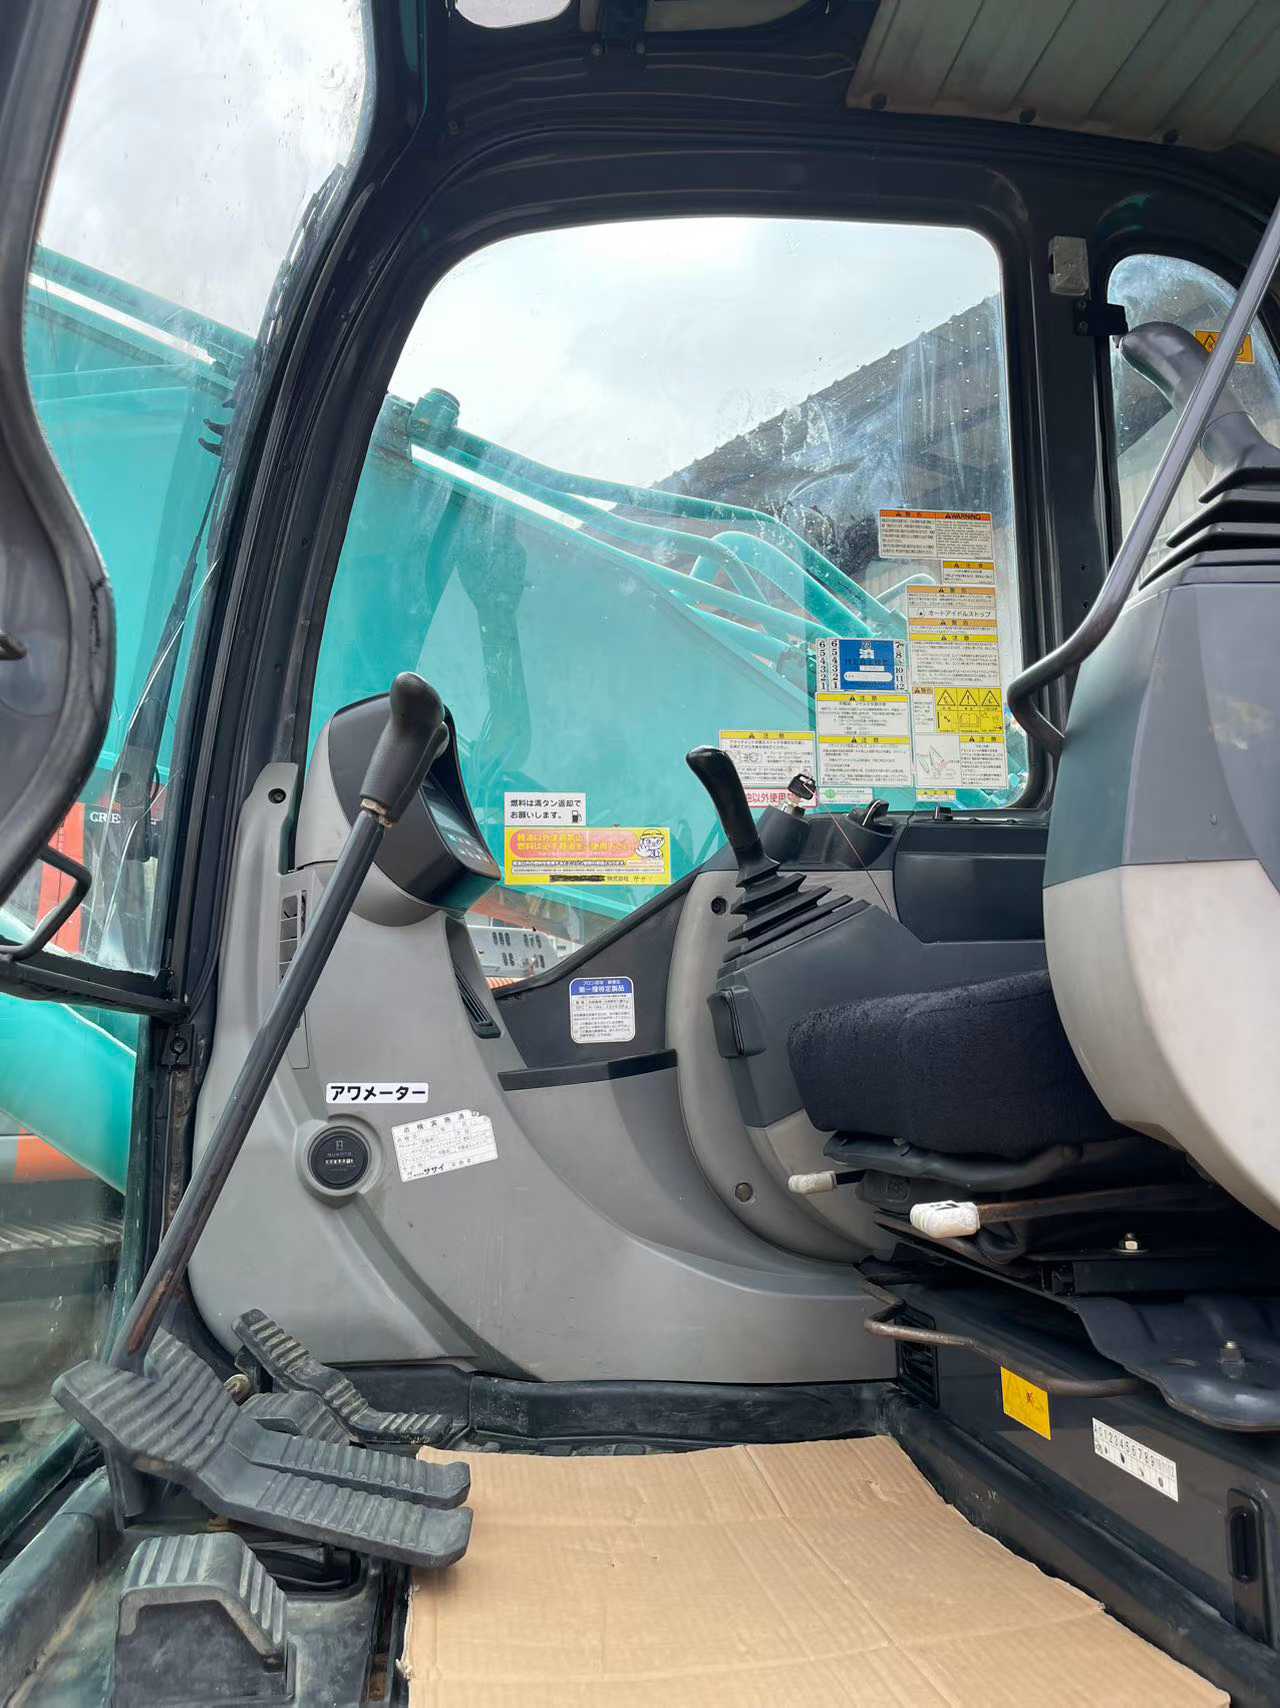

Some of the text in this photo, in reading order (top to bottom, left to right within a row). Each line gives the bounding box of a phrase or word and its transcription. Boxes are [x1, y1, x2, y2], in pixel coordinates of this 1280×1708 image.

[510, 799, 582, 808] 燃料は満タン返却で
[510, 811, 563, 820] お願いします。
[330, 1085, 427, 1101] アワメーター
